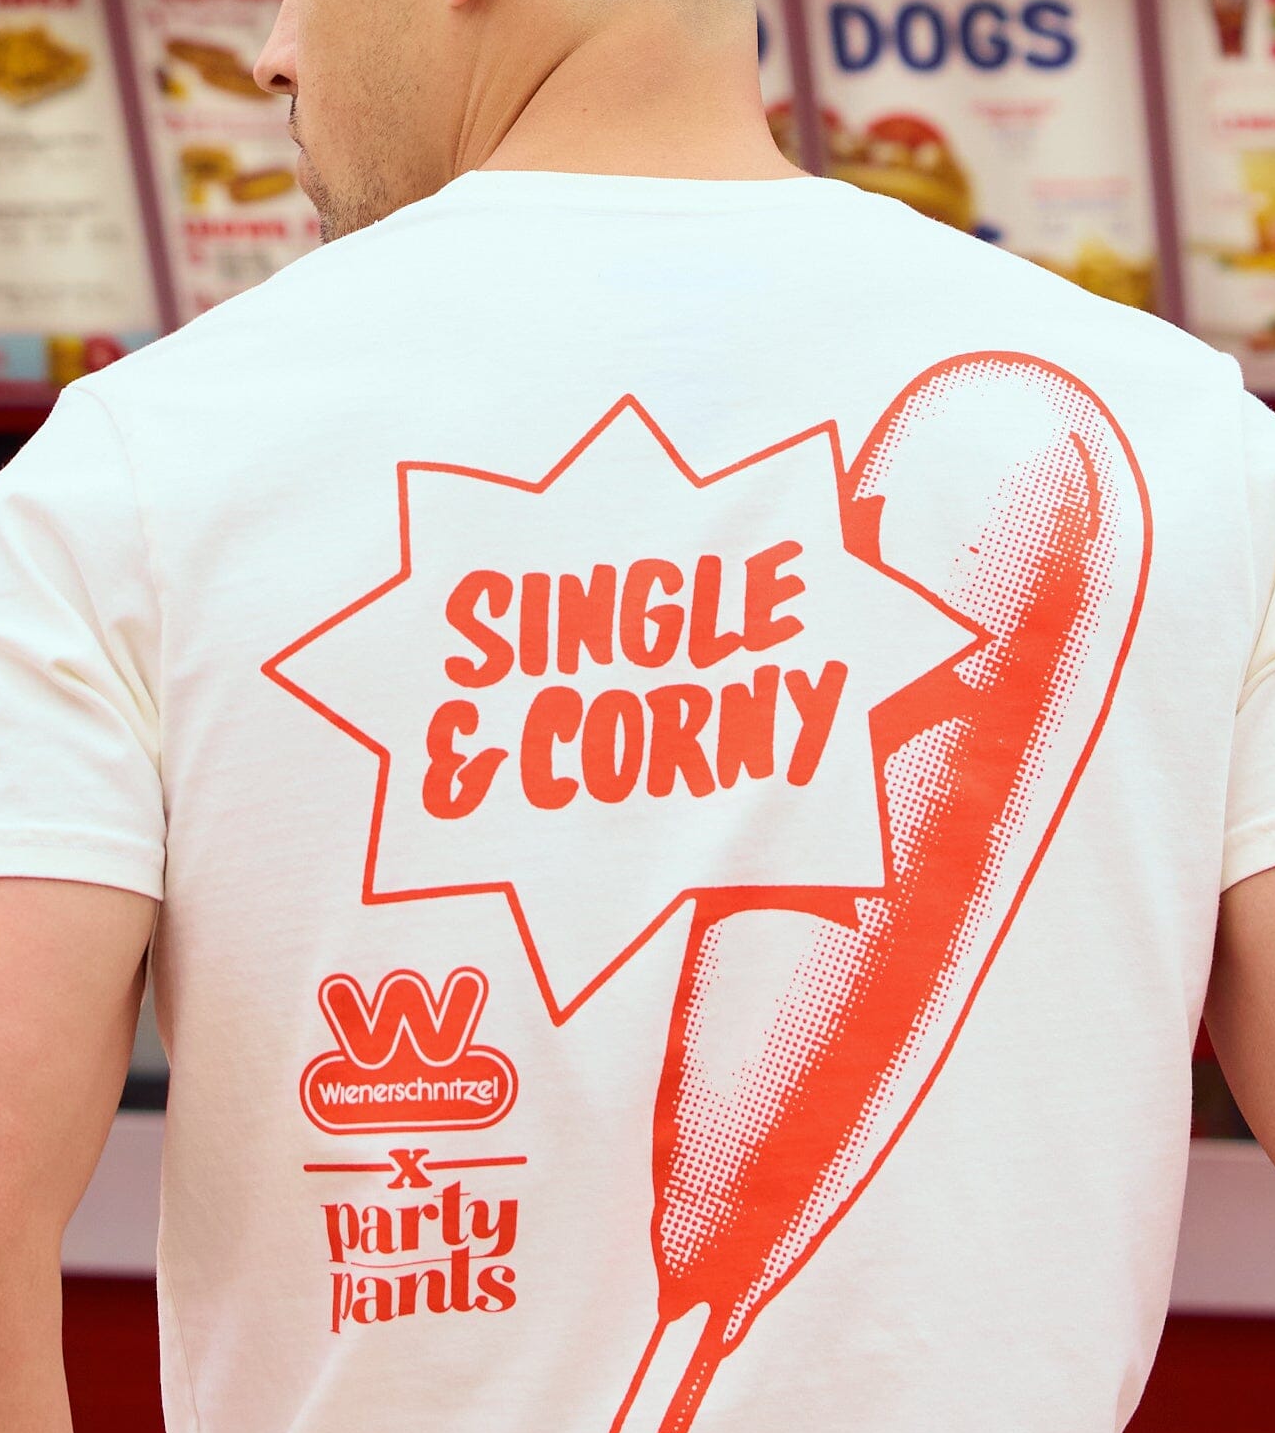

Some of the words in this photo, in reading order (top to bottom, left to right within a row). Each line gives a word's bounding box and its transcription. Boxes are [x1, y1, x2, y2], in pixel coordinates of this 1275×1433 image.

[444, 539, 806, 689] SINGLE
[421, 699, 509, 820] &
[519, 660, 850, 811] CORNY
[320, 968, 487, 1070] W
[318, 1076, 499, 1106] Wienerschnitzel
[319, 1180, 518, 1268] party
[329, 1244, 517, 1334] pants
